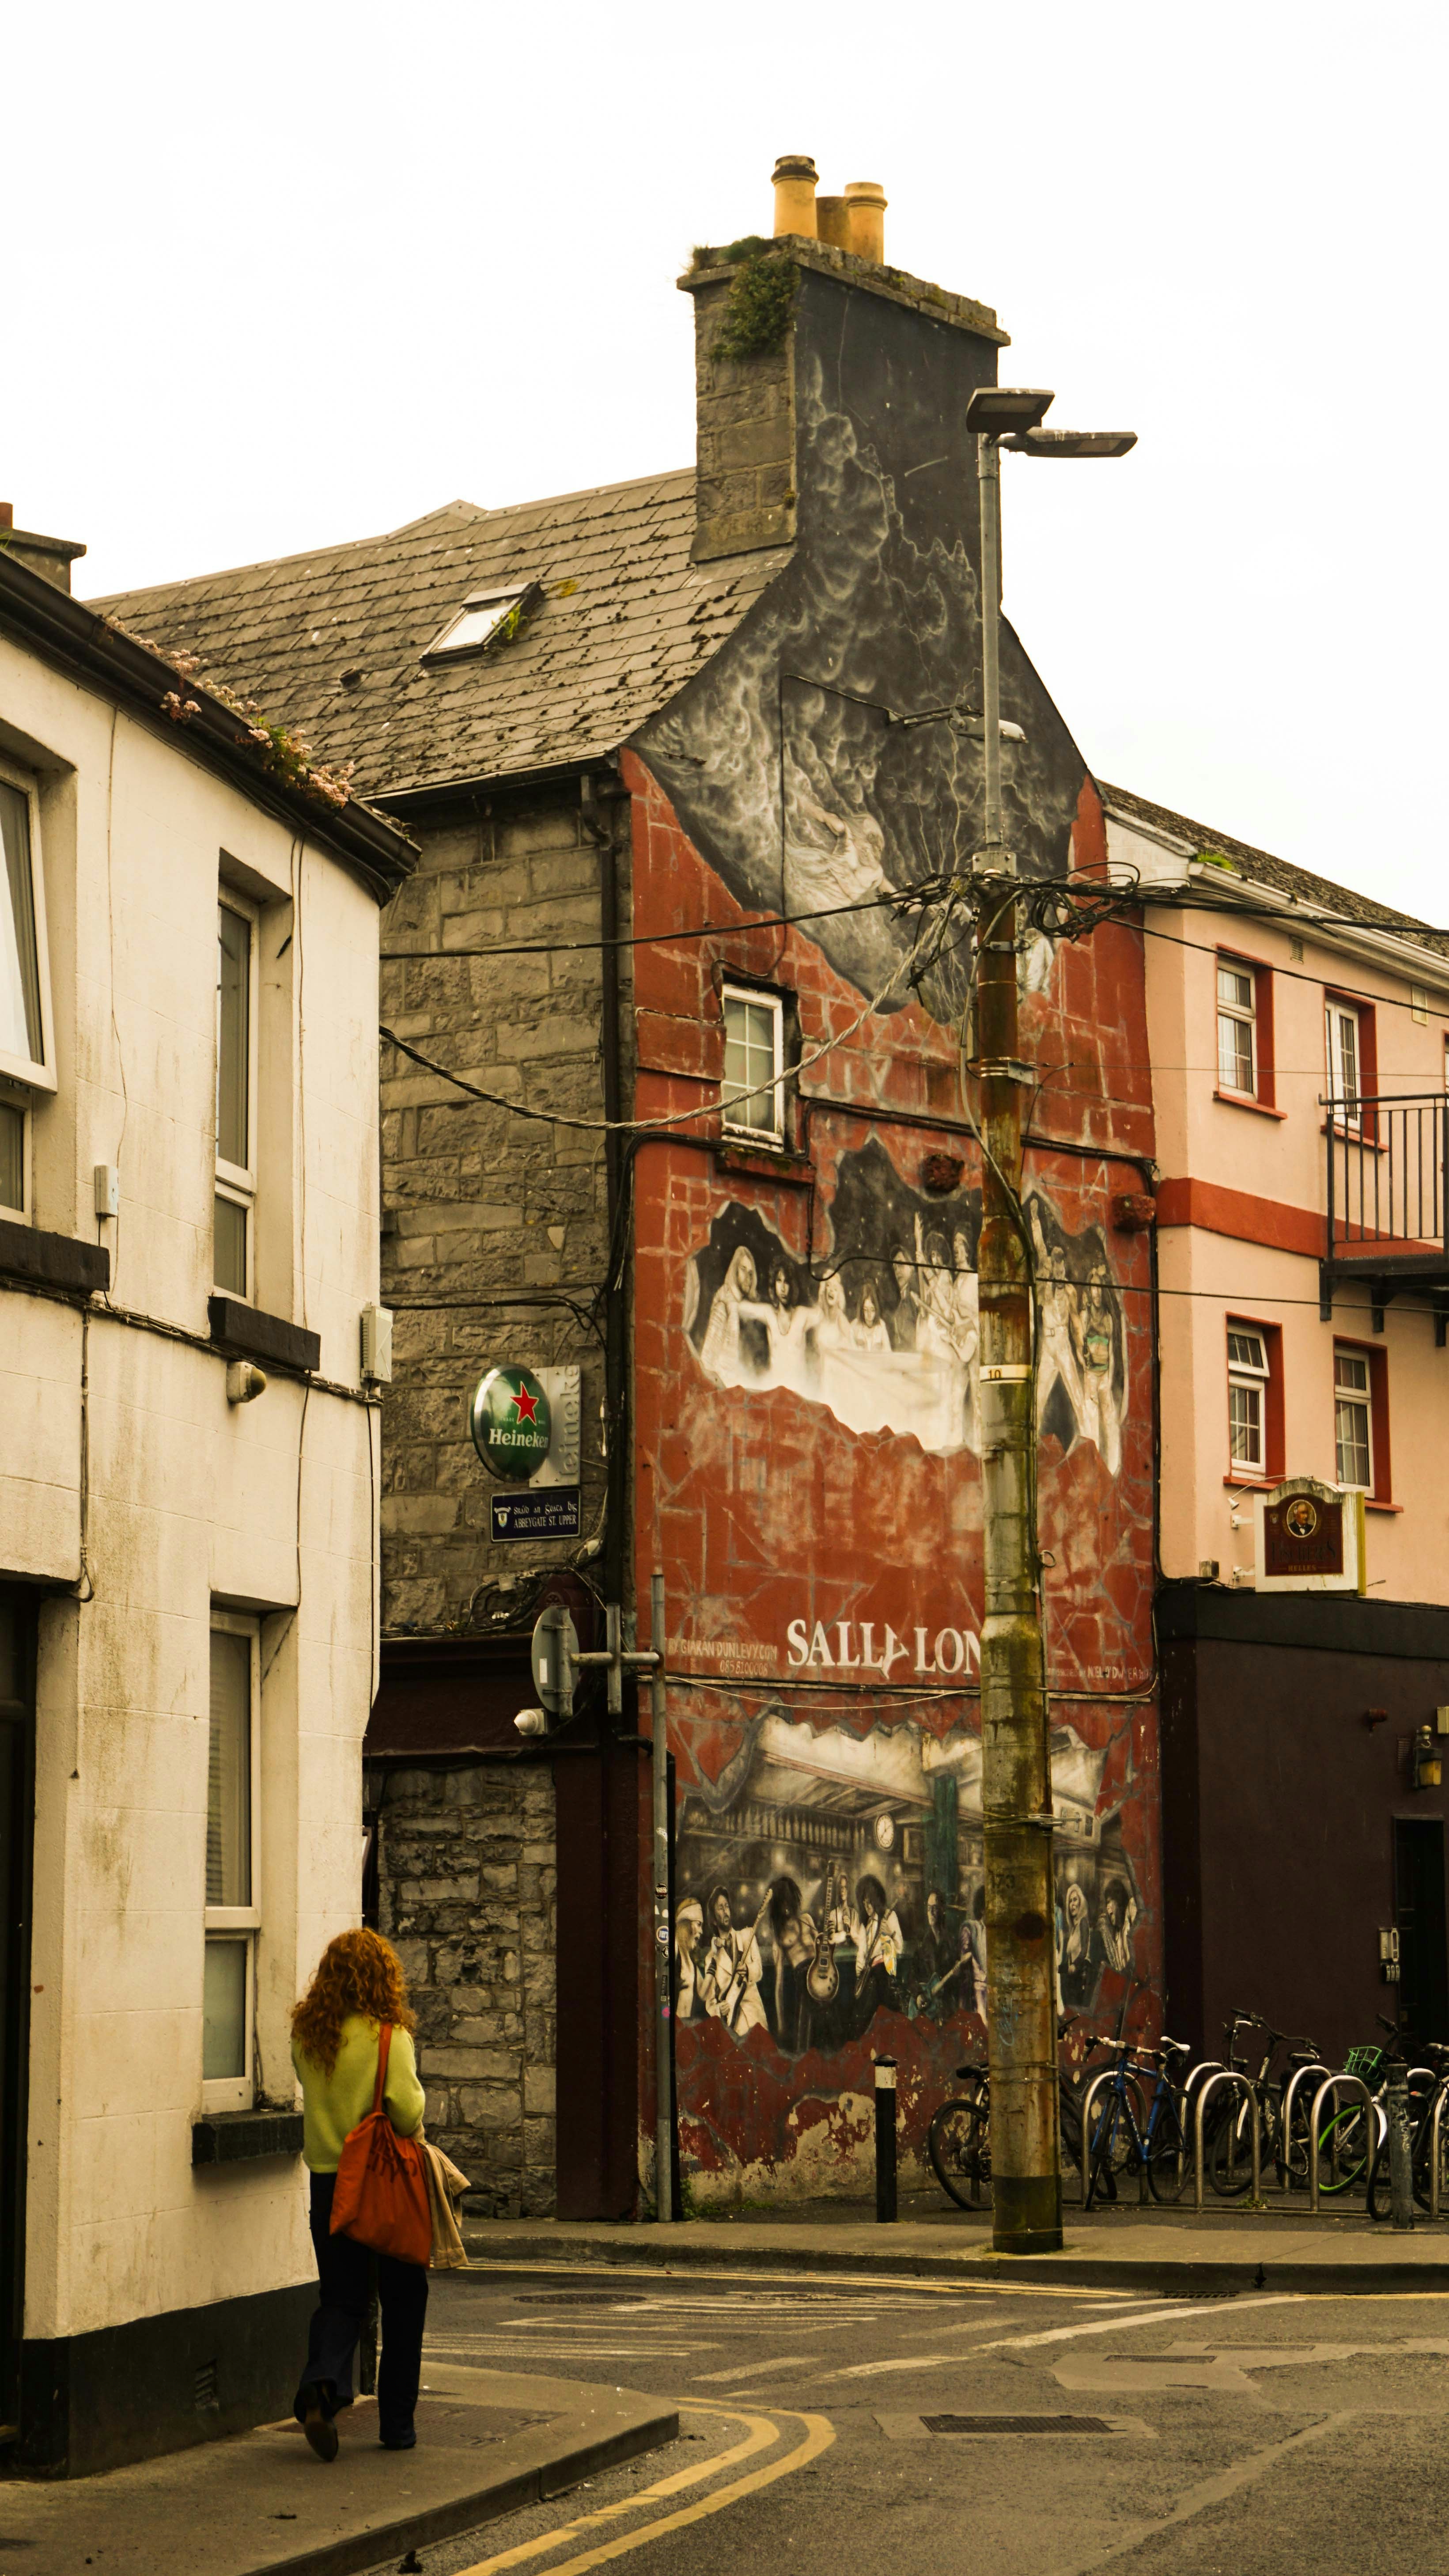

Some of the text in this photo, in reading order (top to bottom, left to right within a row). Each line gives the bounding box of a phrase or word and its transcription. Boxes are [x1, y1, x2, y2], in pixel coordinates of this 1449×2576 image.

[989, 1370, 1001, 1379] 10
[488, 1428, 549, 1448] Heineken
[514, 1516, 546, 1528] ABBEYGATE
[559, 1514, 577, 1525] UPPER
[787, 1619, 909, 1679] SALLY
